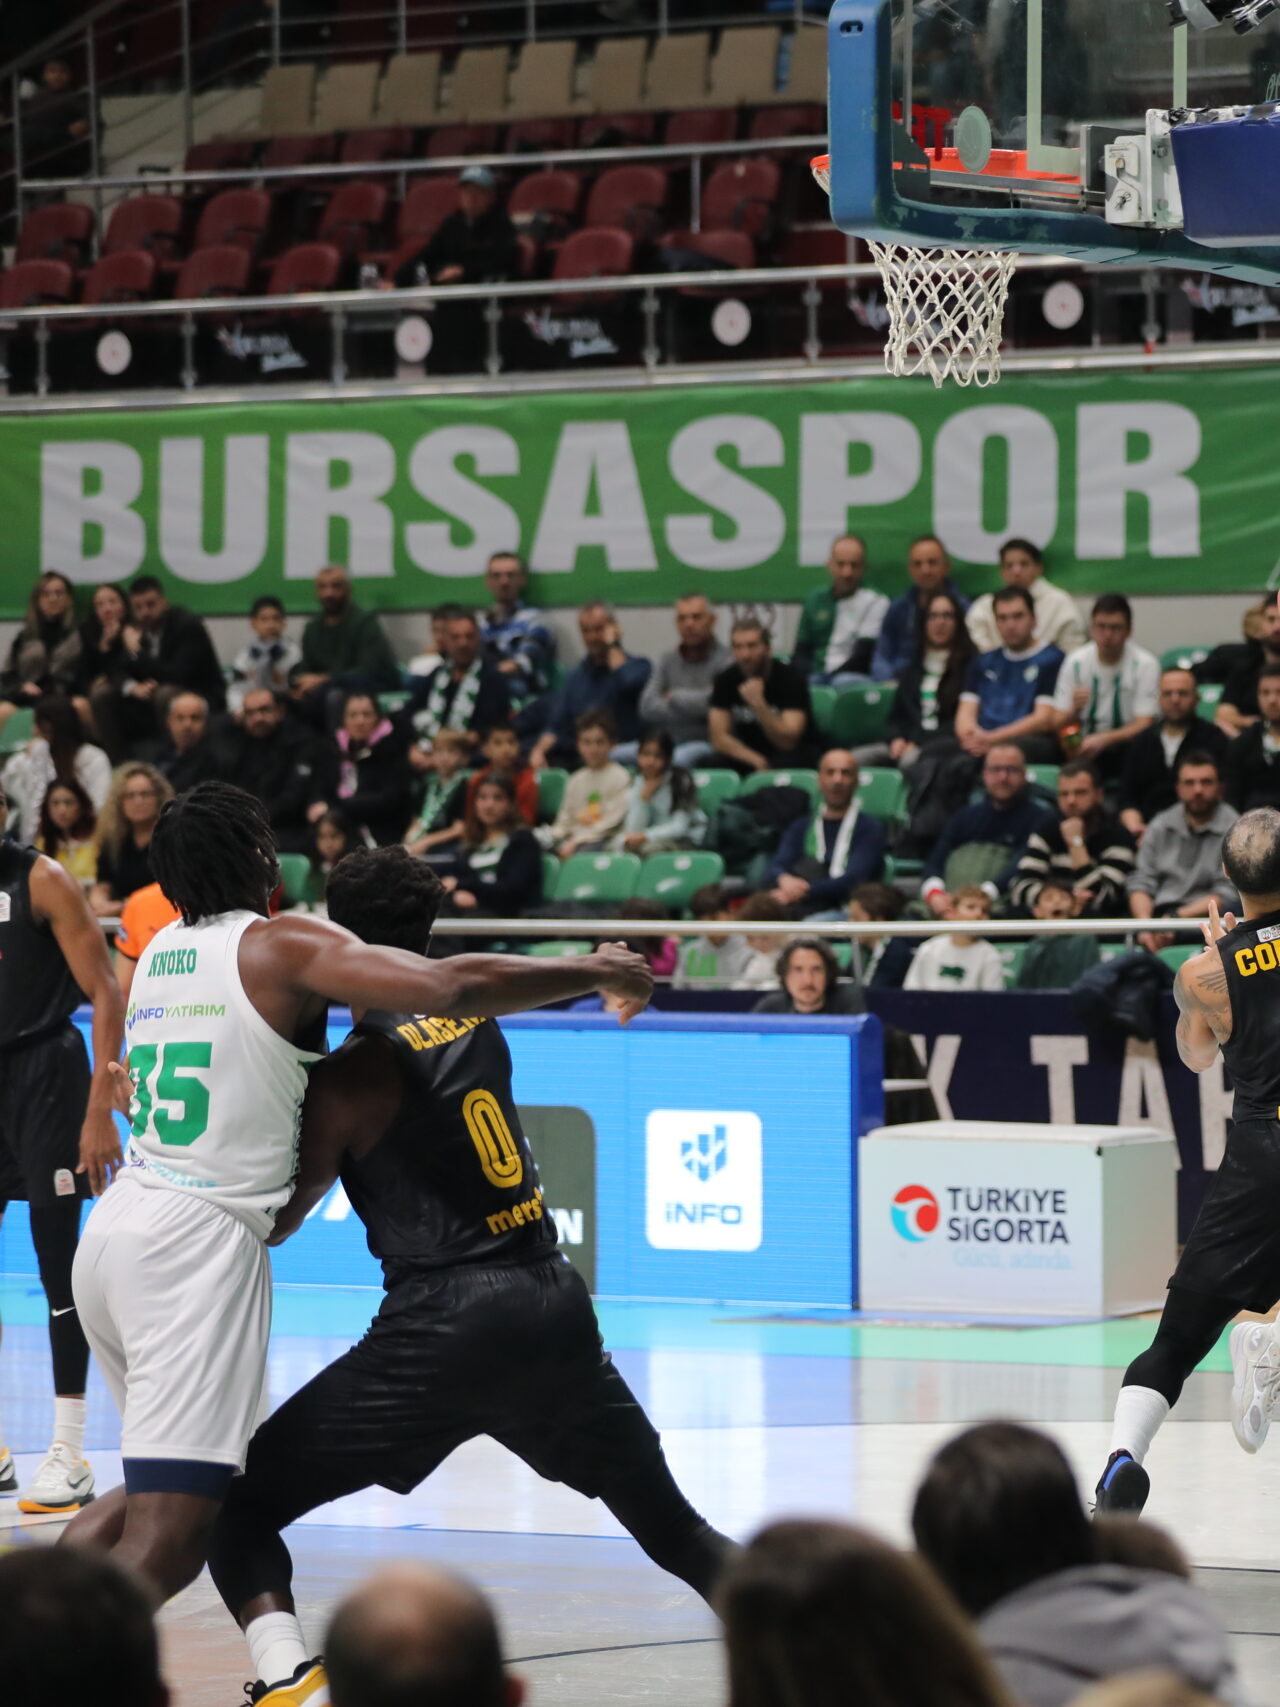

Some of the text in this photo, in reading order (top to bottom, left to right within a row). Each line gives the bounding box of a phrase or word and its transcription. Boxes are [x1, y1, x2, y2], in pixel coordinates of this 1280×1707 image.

[39, 401, 1202, 586] BURSASPOR
[147, 947, 198, 978] NNOKO
[461, 1088, 524, 1189] 0
